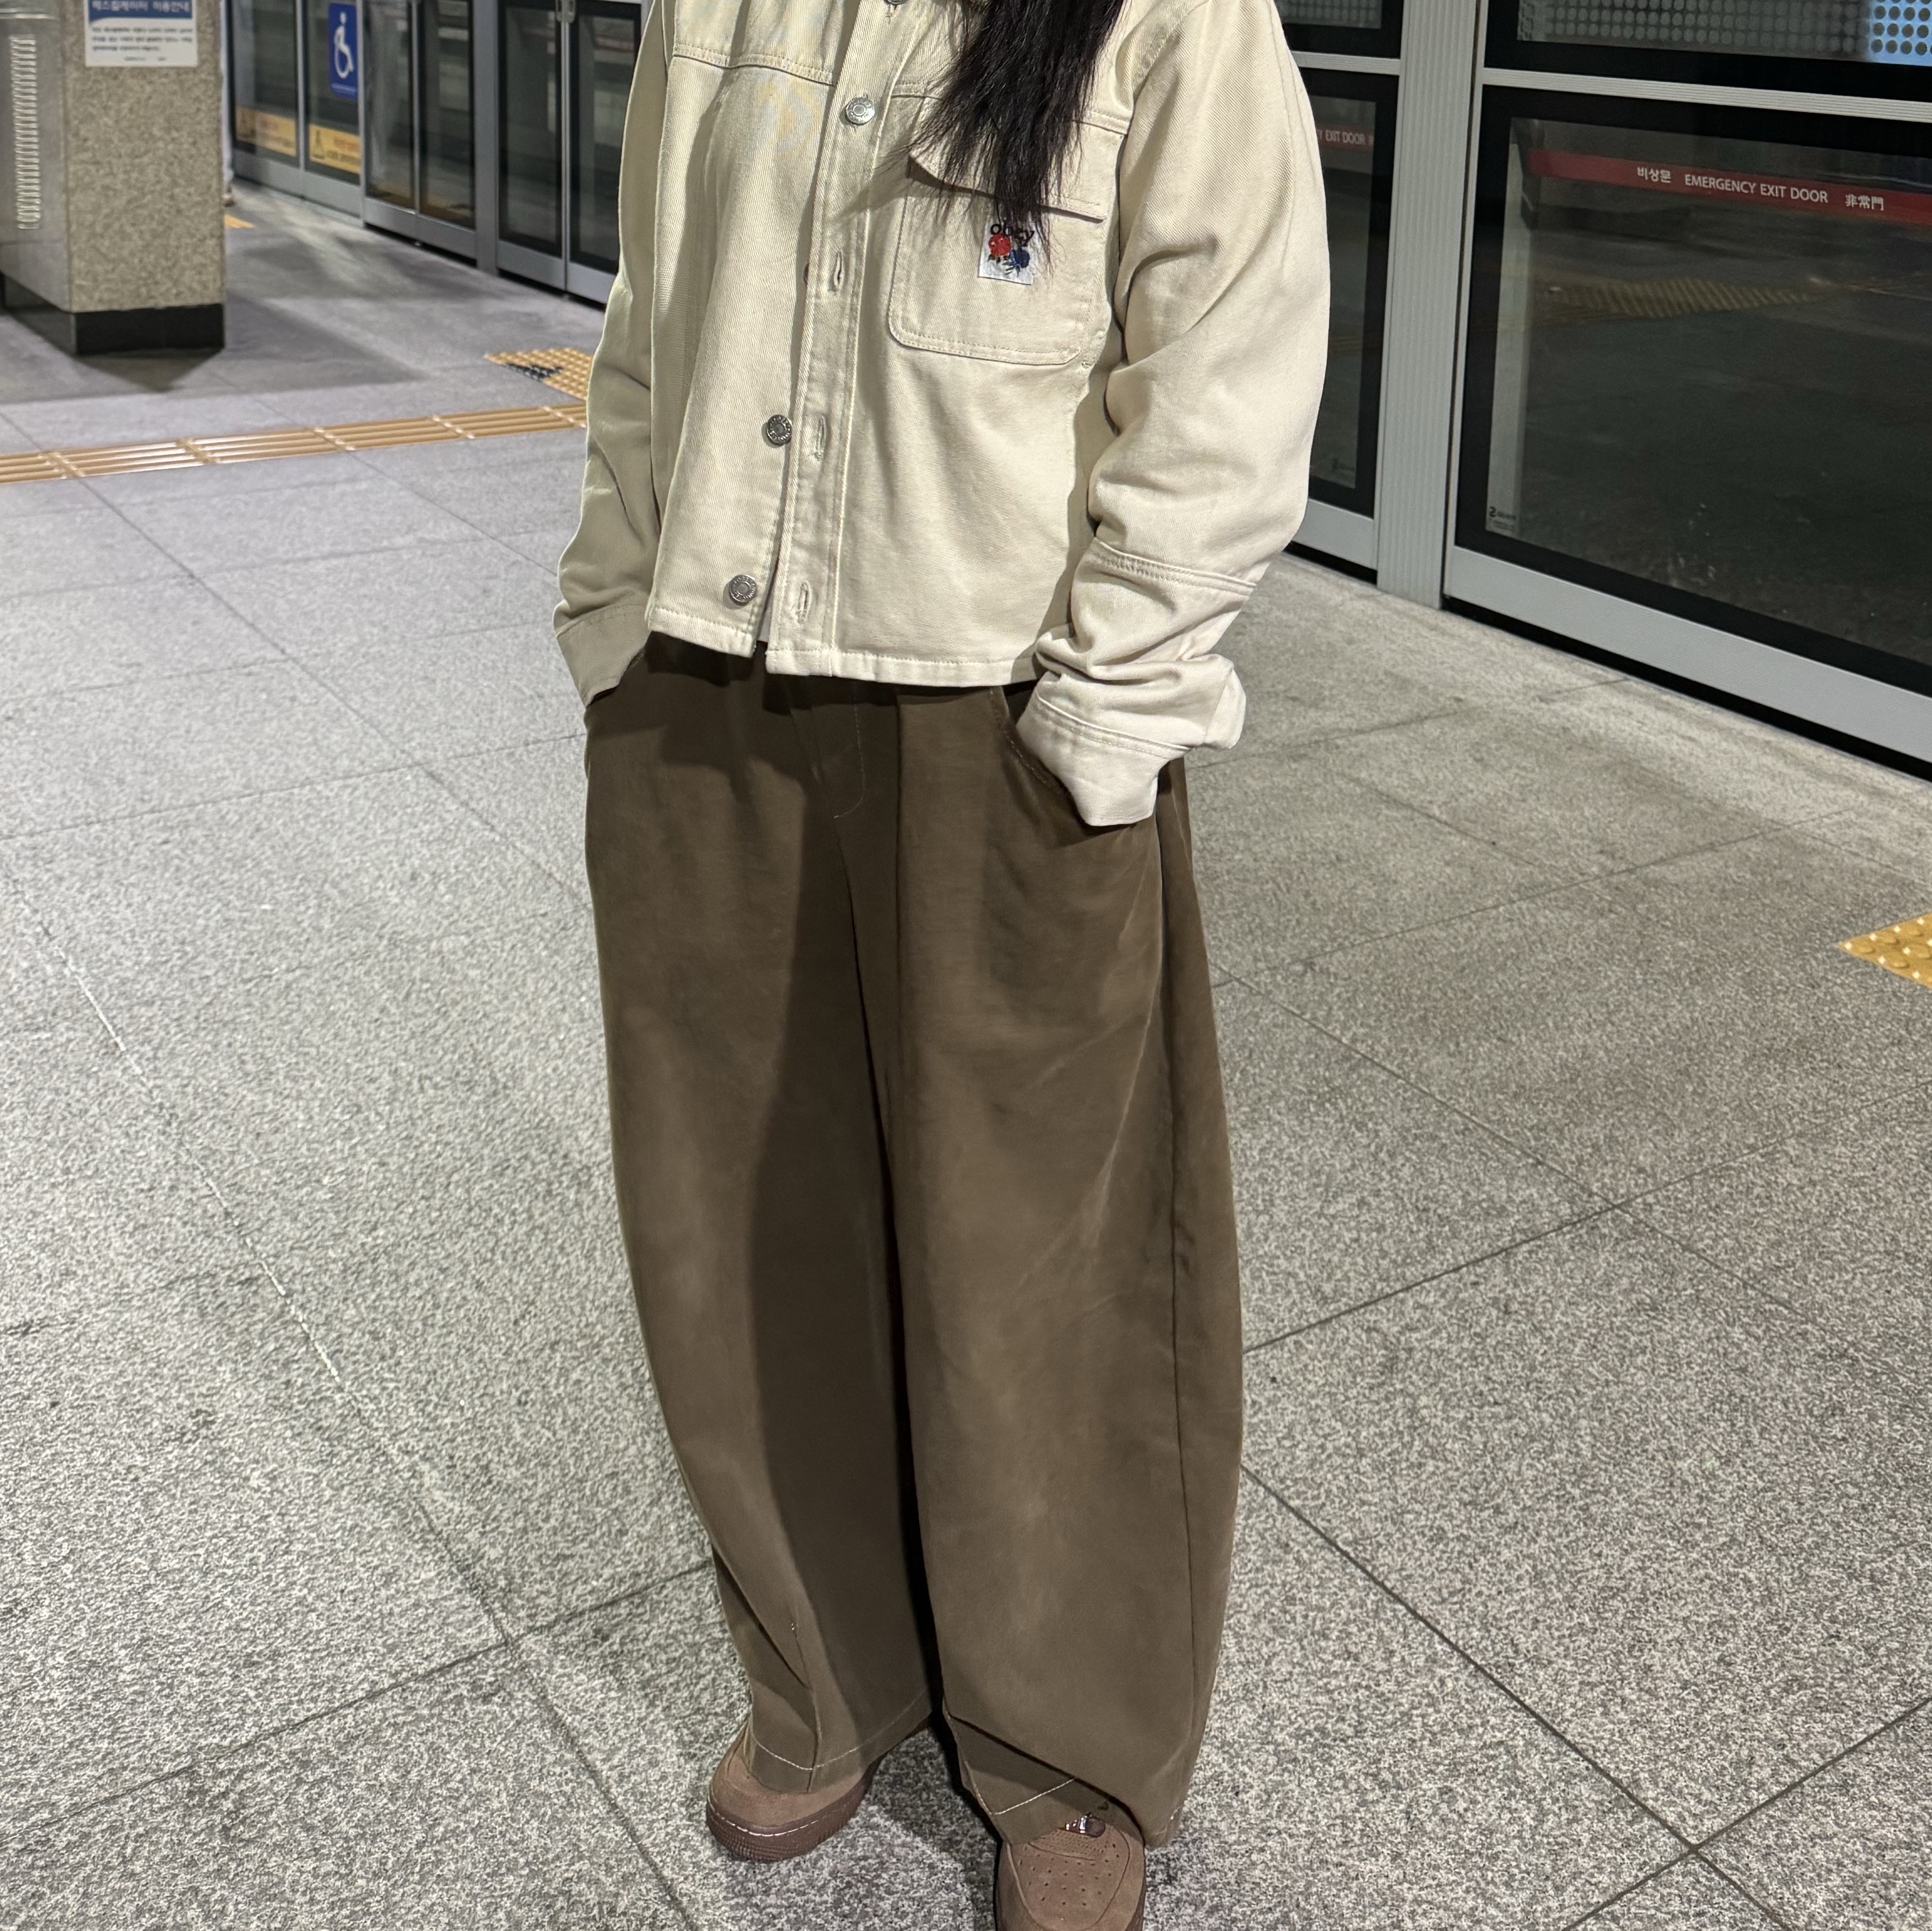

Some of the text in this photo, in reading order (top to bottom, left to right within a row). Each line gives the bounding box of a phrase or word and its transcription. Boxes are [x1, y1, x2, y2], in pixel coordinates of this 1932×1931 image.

[1325, 130, 1341, 142] EXIT
[1342, 131, 1366, 145] DOOR
[1637, 167, 1885, 211] 비상문 EMERGENCY EXIT DOOR 非常門
